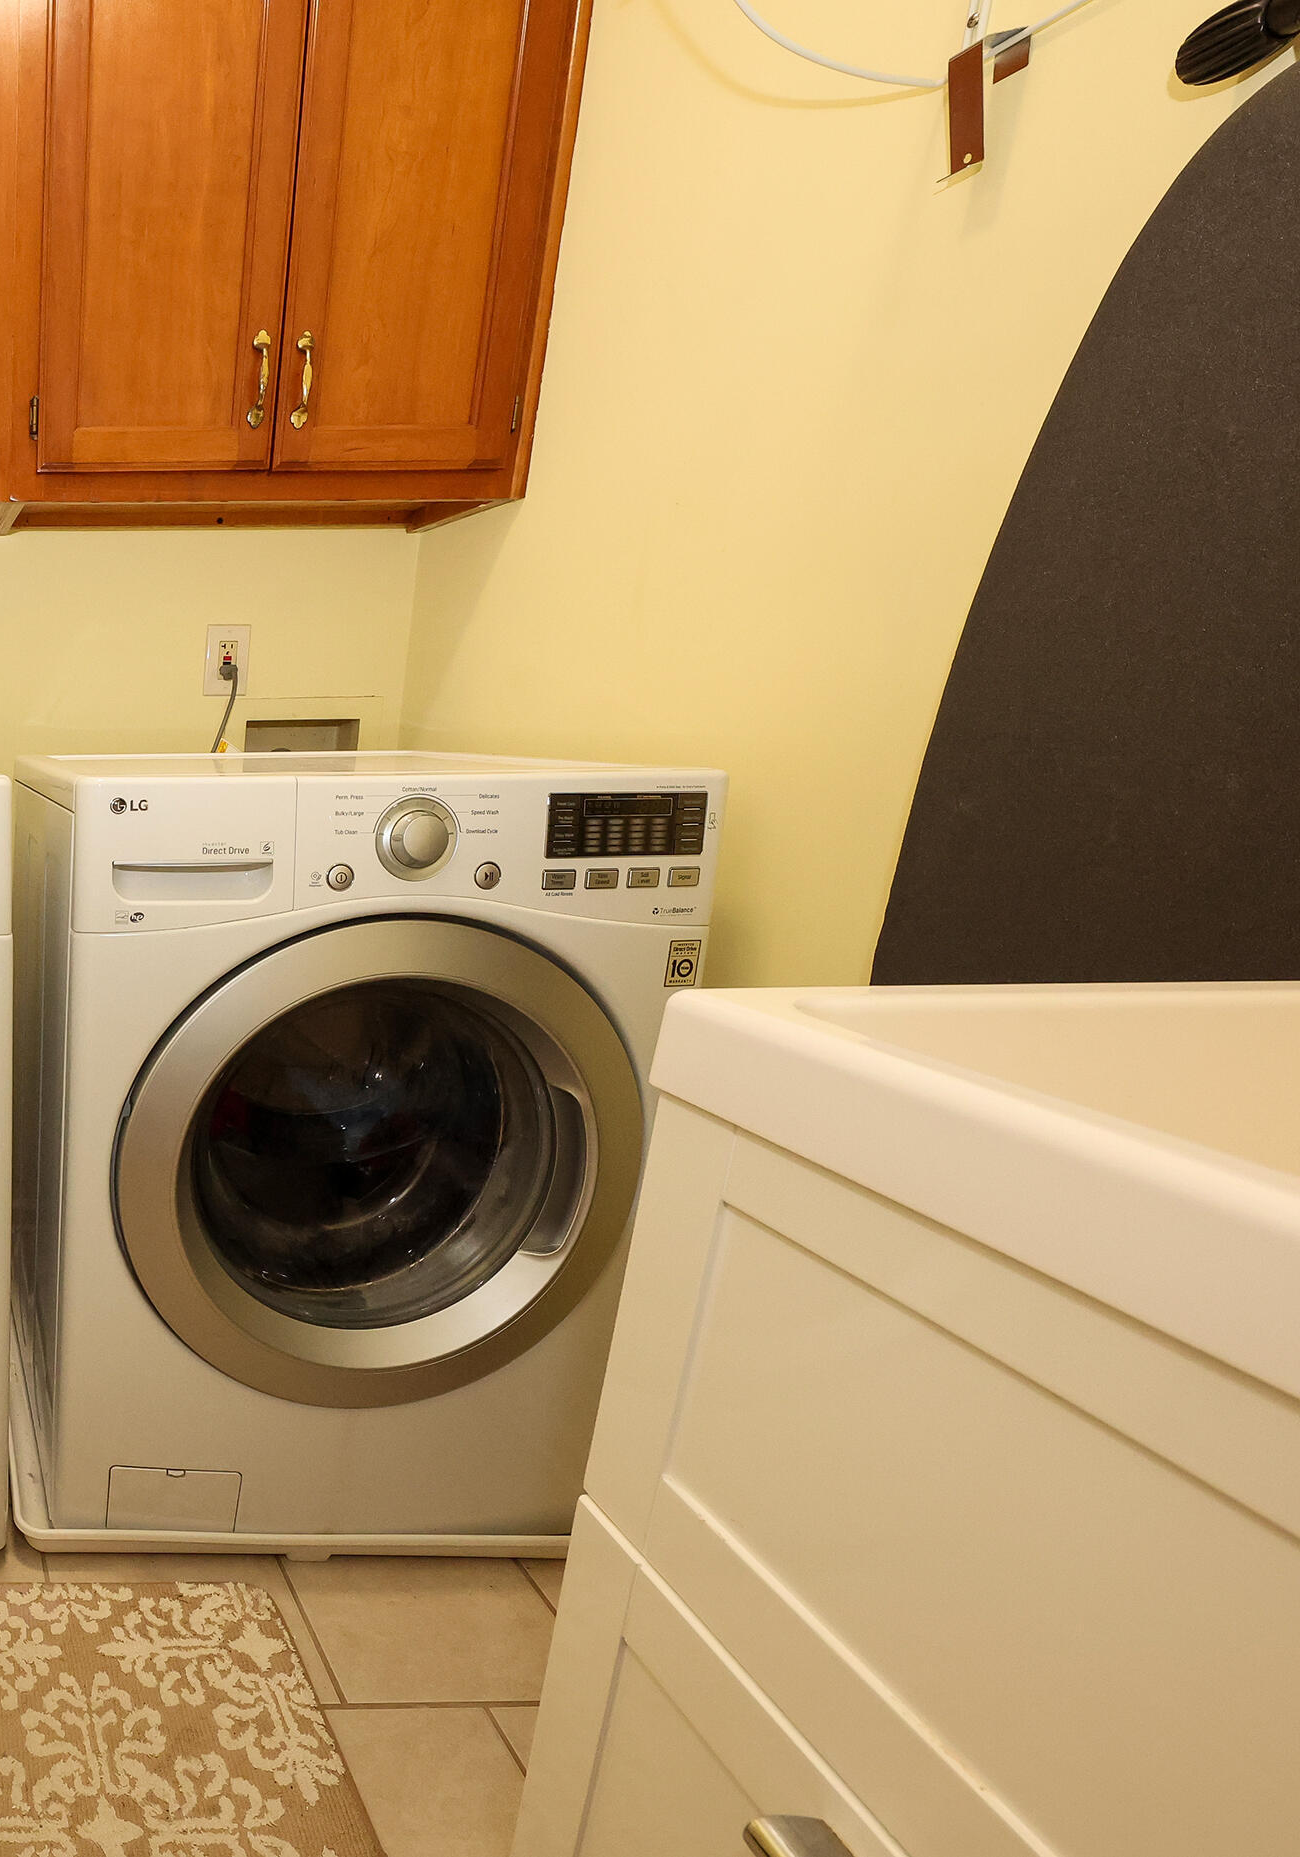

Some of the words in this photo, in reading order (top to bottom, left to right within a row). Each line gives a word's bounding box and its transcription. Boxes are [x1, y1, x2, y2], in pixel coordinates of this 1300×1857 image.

[130, 799, 148, 812] LG
[202, 846, 227, 855] Direct
[228, 846, 250, 855] Drive
[671, 958, 694, 978] 10
